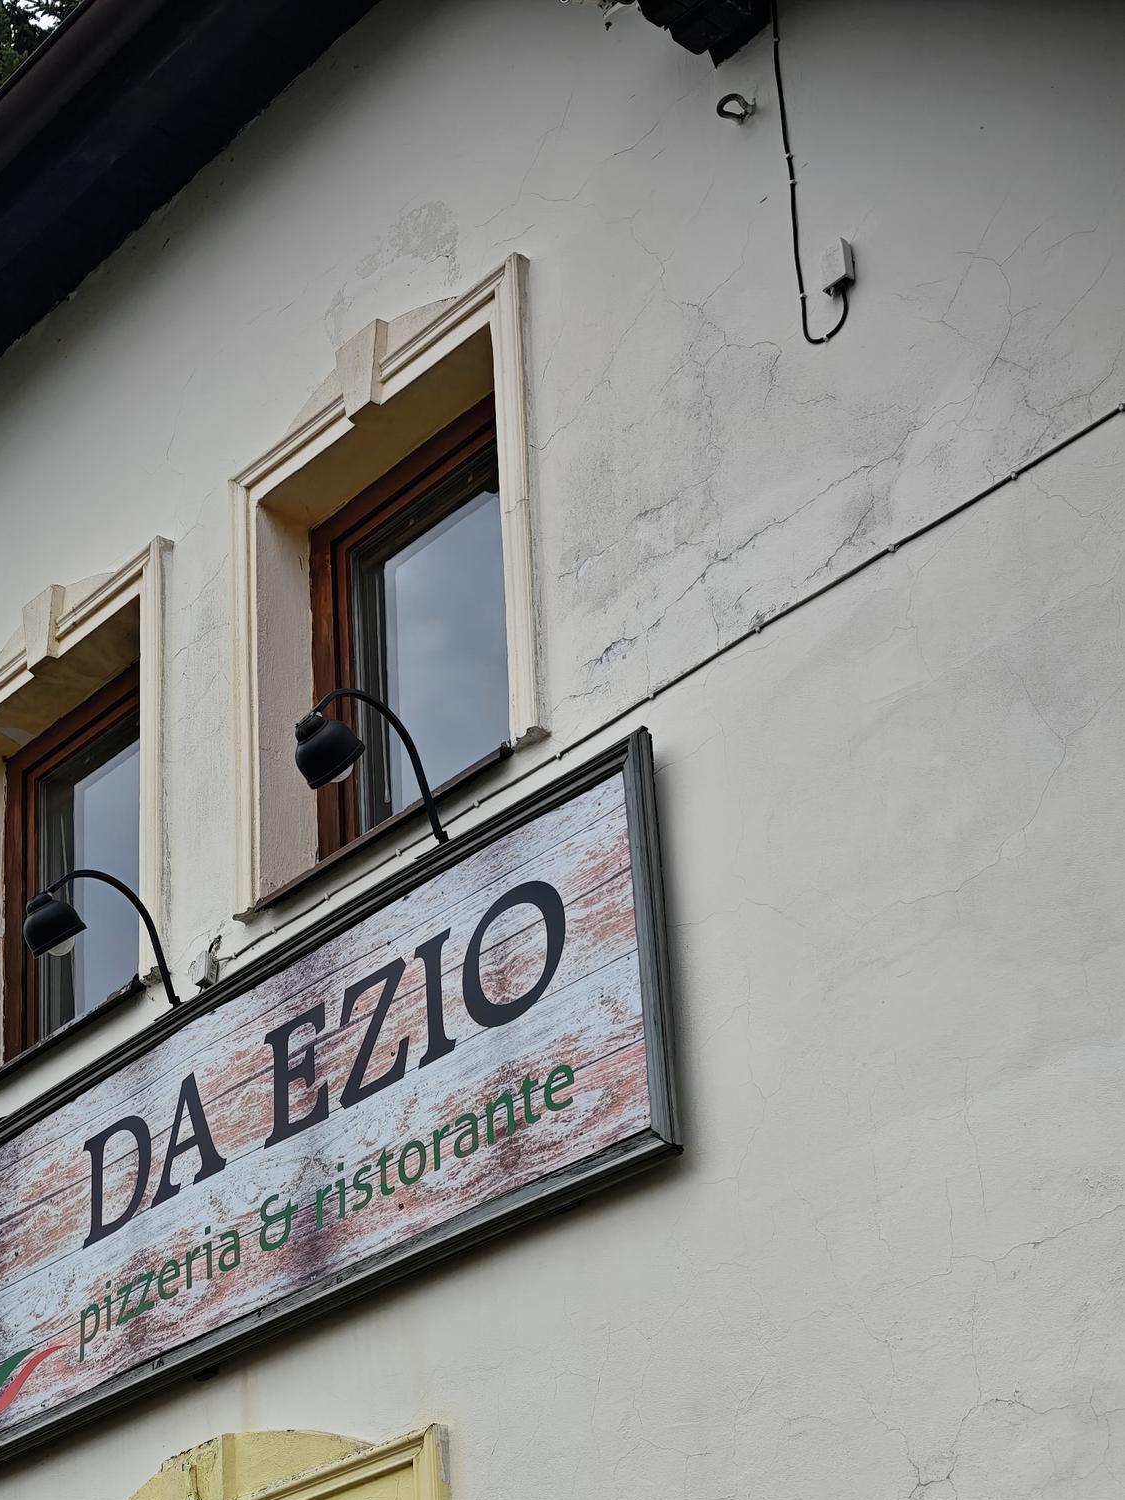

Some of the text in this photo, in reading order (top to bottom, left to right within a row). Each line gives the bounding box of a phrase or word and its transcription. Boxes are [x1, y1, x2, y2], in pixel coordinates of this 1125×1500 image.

[79, 1065, 576, 1361] pizzeria & ristorante
[83, 880, 566, 1249] DA EZIO
